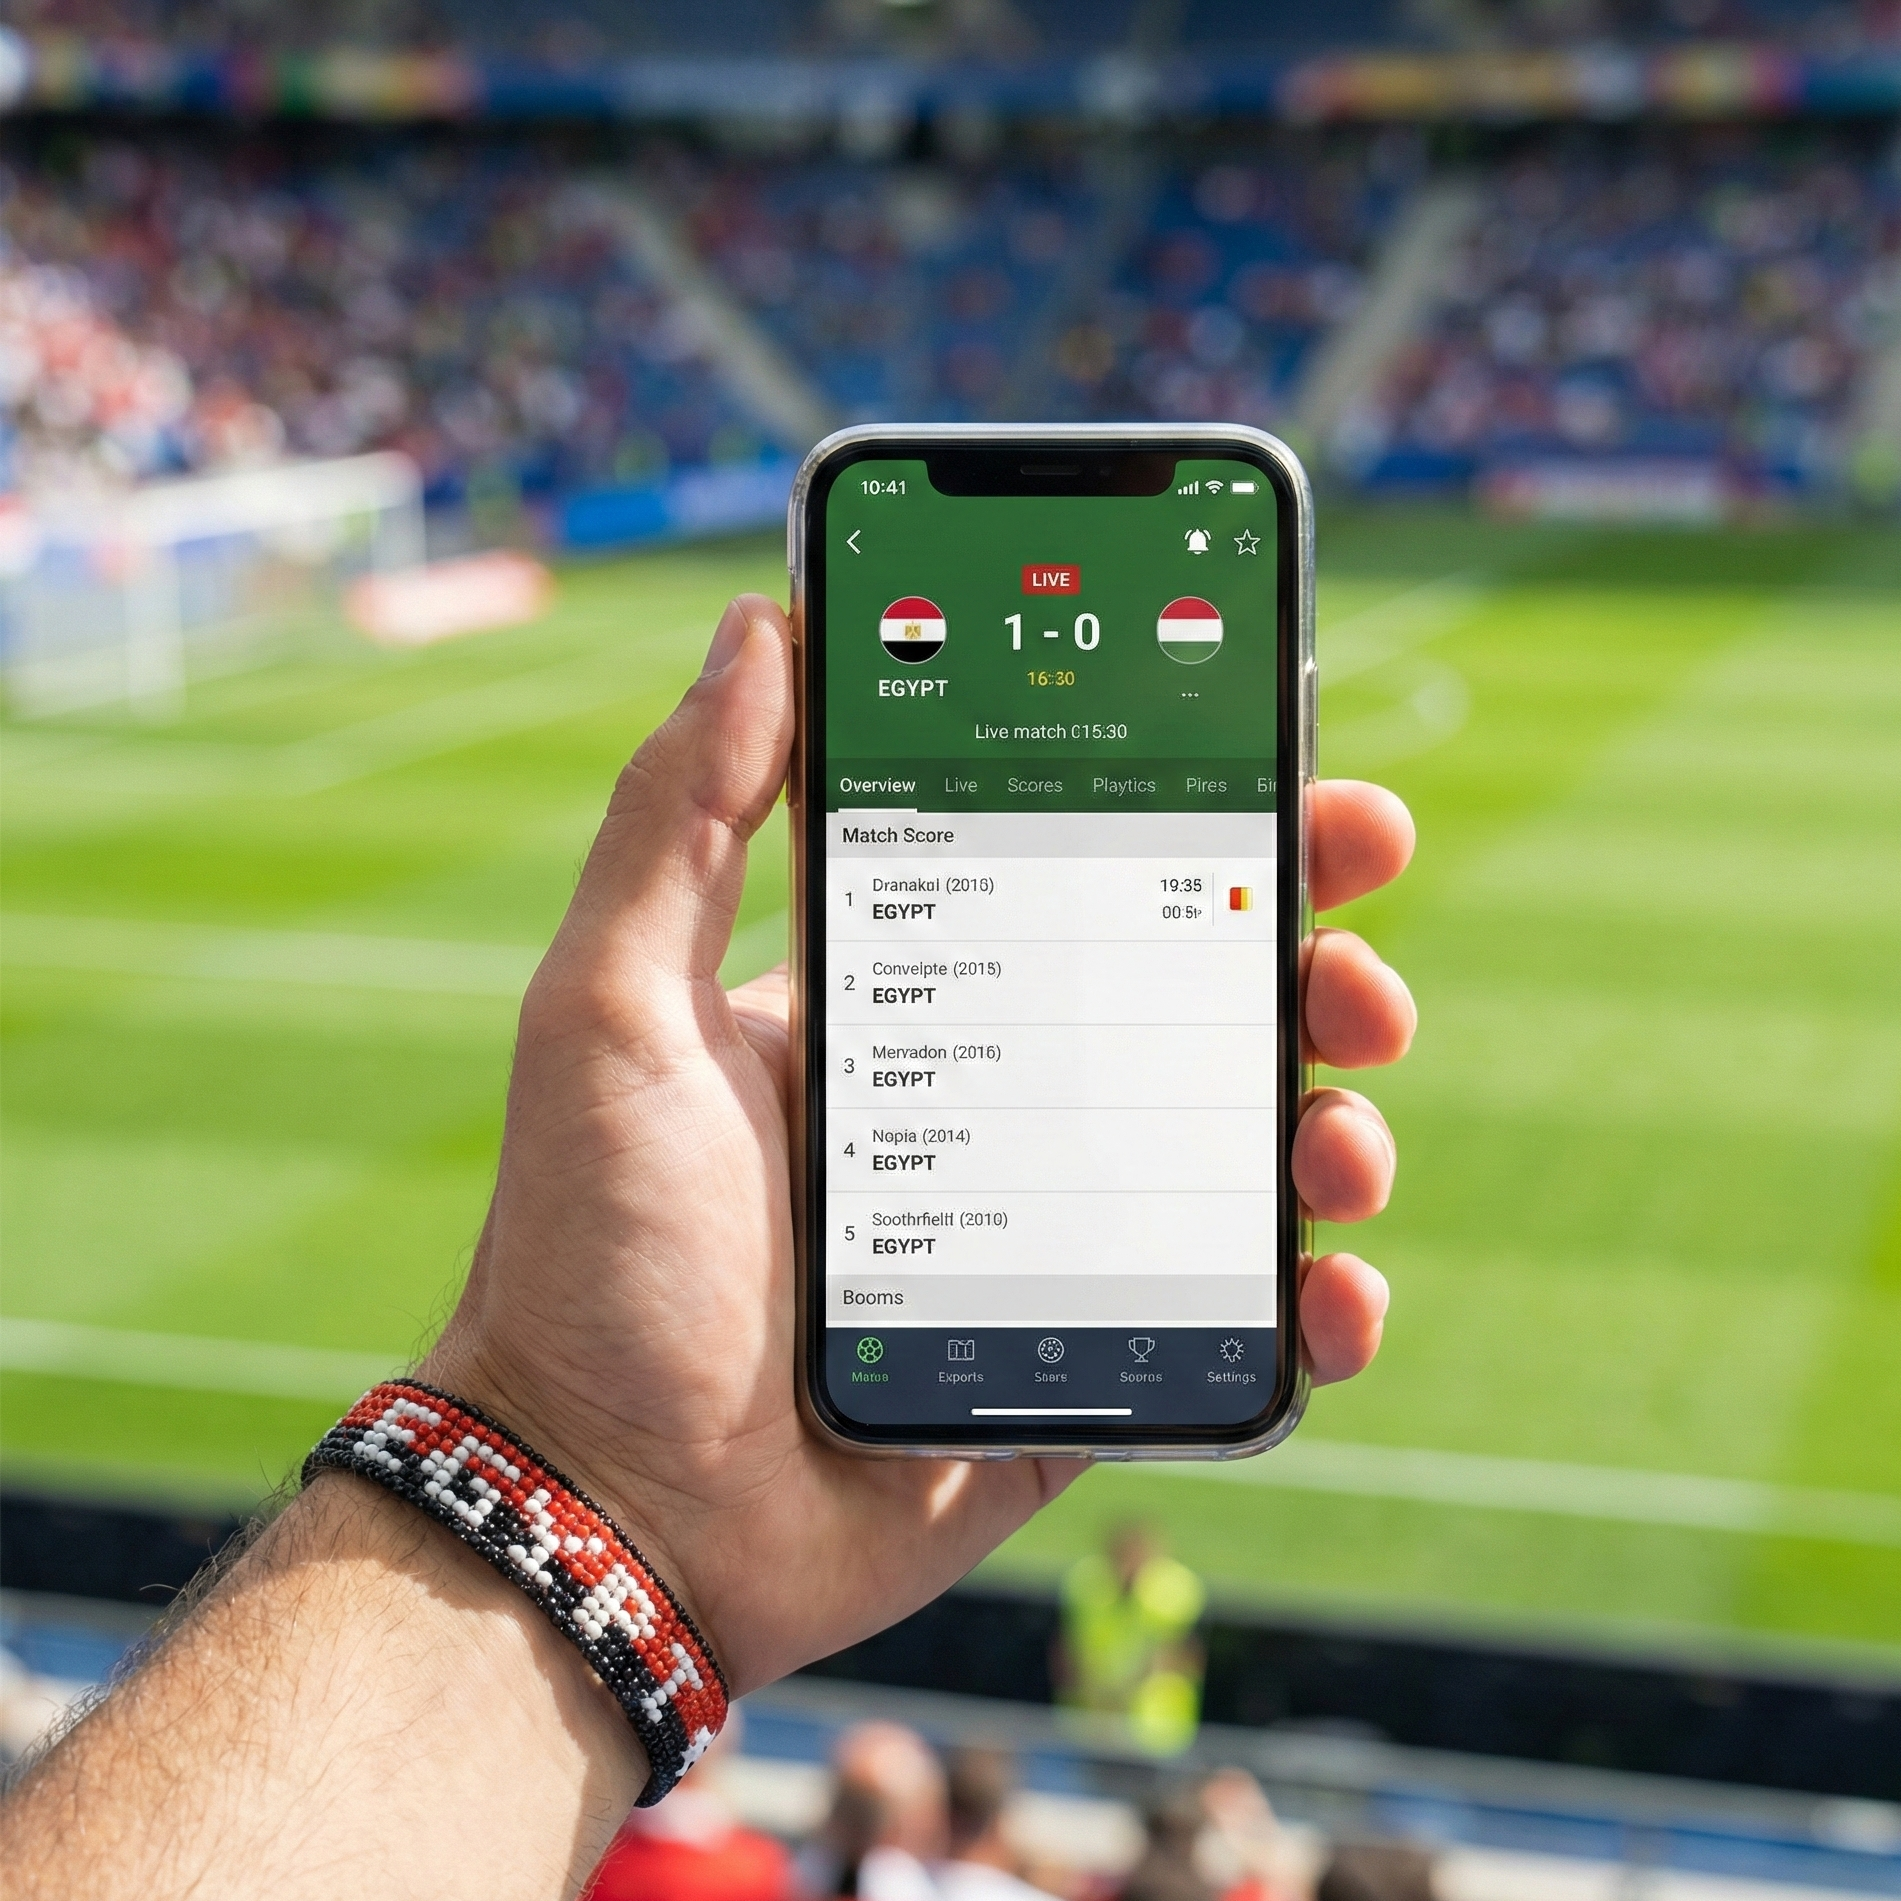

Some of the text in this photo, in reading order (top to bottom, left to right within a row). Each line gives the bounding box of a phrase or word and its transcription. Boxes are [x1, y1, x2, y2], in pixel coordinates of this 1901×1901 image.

[860, 479, 906, 495] 10:41
[1032, 572, 1070, 587] LIVE
[1004, 613, 1022, 651] 1
[1074, 612, 1100, 651] 0
[1027, 670, 1075, 686] 16:30
[878, 679, 949, 697] EGYPT
[975, 723, 1009, 739] Live
[1014, 723, 1067, 739] match
[839, 777, 916, 793] Overview
[945, 777, 978, 793] Live
[1007, 777, 1063, 793] Scores
[1093, 777, 1156, 797] Playtics
[1186, 777, 1227, 793] Pires
[842, 826, 955, 843] Match Score
[1160, 878, 1202, 893] 19:35
[844, 891, 852, 907] 1
[872, 903, 937, 920] EGYPT
[844, 974, 856, 991] 2
[872, 987, 937, 1004] EGYPT
[952, 1044, 1001, 1063] (2016)
[844, 1057, 855, 1074] 3
[872, 1070, 936, 1088] EGYPT
[872, 1128, 971, 1146] Nopia (2014)
[843, 1142, 856, 1158] 4
[872, 1154, 937, 1171] EGYPT
[844, 1225, 855, 1242] 5
[872, 1238, 936, 1255] EGYPT
[843, 1289, 904, 1305] Booms
[1207, 1371, 1257, 1385] Settings
